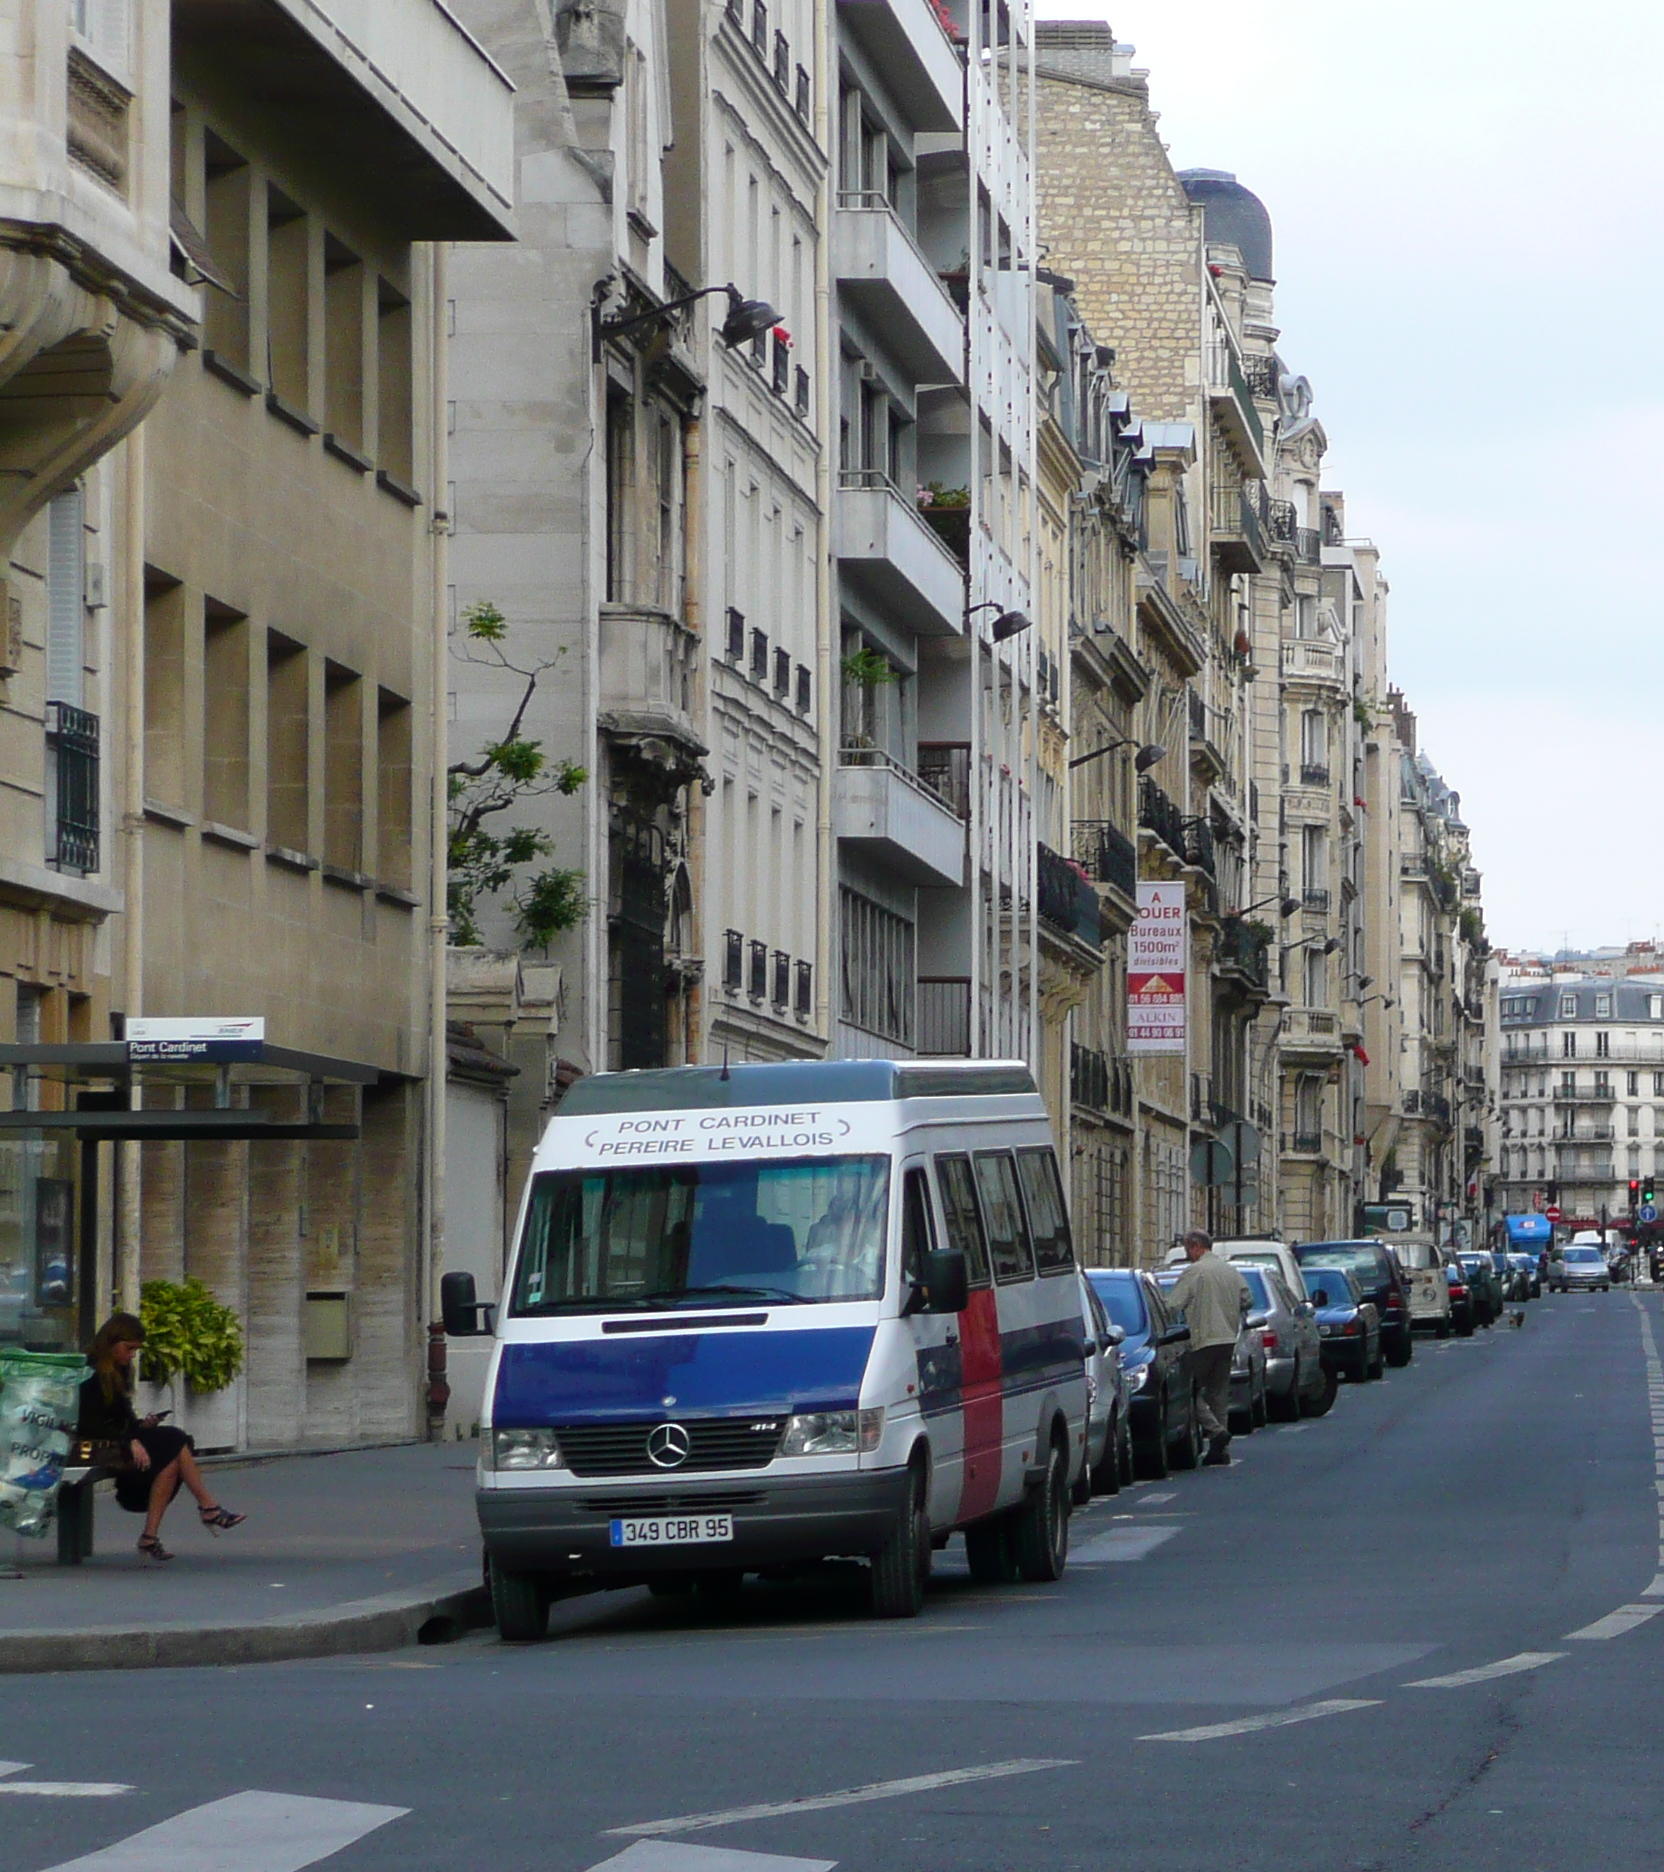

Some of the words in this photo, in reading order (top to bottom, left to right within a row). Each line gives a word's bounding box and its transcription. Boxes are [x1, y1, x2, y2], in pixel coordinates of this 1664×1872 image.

[1151, 892, 1161, 903] A
[1137, 907, 1181, 919] OUER
[1131, 926, 1182, 937] Bureaux
[1134, 957, 1179, 966] divisibles
[1136, 1012, 1176, 1023] ALKIN
[130, 1043, 156, 1053] Pont
[159, 1042, 207, 1052] Cardinet
[618, 1119, 686, 1134] PONT
[699, 1111, 822, 1131] CARDINET
[598, 1138, 695, 1156] PEREIRE
[707, 1132, 834, 1151] LEVALLOIS
[626, 1522, 660, 1541] 349
[665, 1520, 700, 1539] CBR
[705, 1518, 729, 1537] 95
